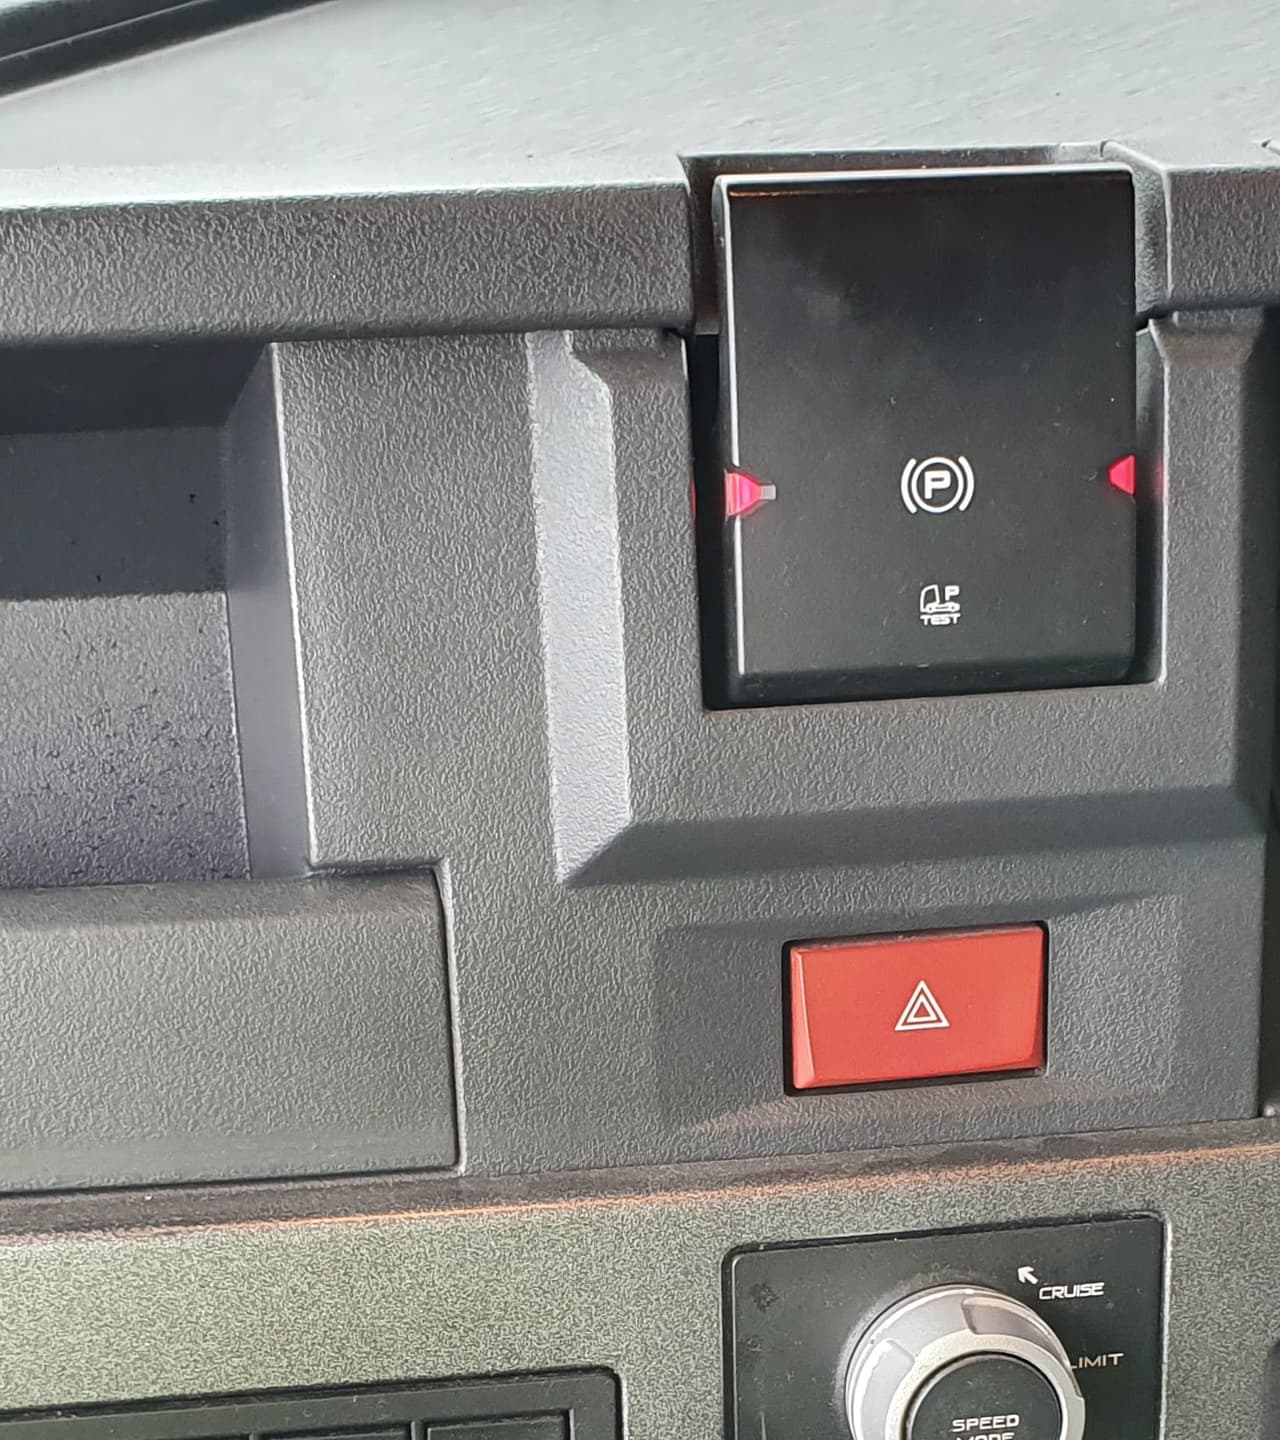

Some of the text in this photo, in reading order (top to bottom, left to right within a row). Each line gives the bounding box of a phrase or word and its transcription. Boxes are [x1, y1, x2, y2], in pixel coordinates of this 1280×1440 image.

[924, 470, 951, 499] P
[945, 586, 960, 600] P
[920, 613, 961, 625] TEST
[1039, 1282, 1105, 1300] CRUISE
[952, 1414, 1020, 1432] SPEED
